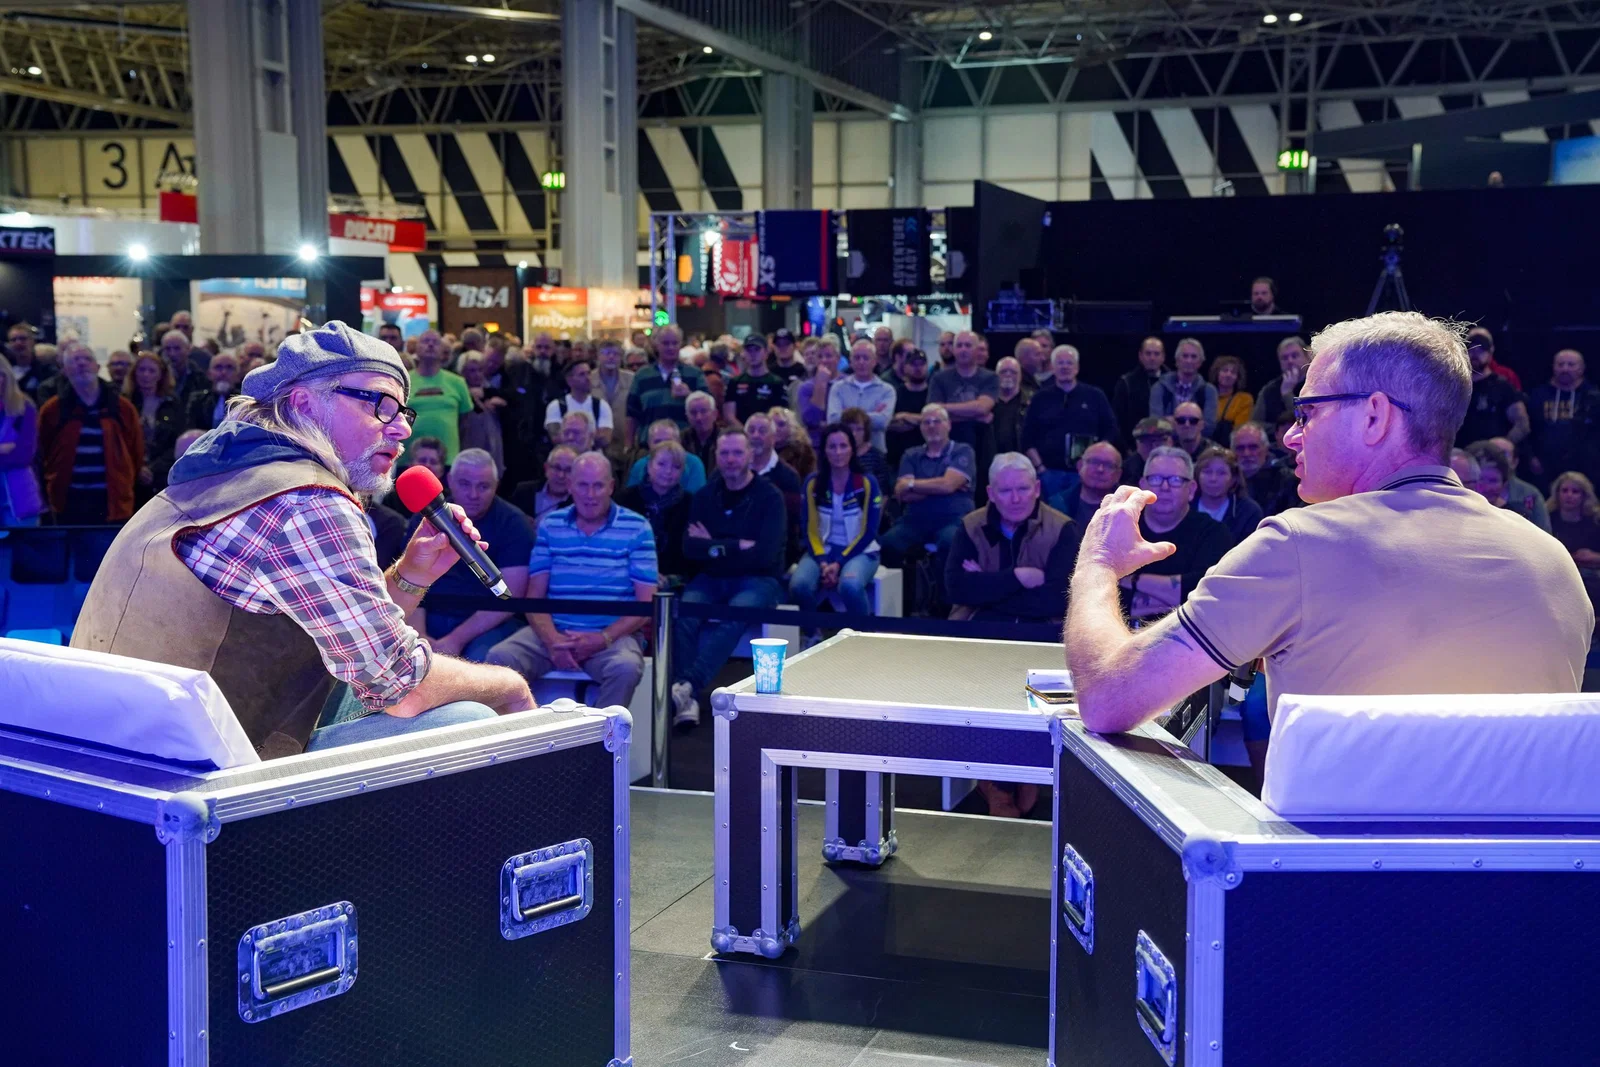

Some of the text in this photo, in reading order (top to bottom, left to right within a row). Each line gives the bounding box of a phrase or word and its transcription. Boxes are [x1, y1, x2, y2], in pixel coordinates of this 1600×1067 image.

[102, 142, 127, 190] 3
[344, 219, 396, 244] DUCATI
[892, 216, 905, 287] ADVENTURE
[904, 248, 917, 287] READY
[457, 284, 510, 309] BSA
